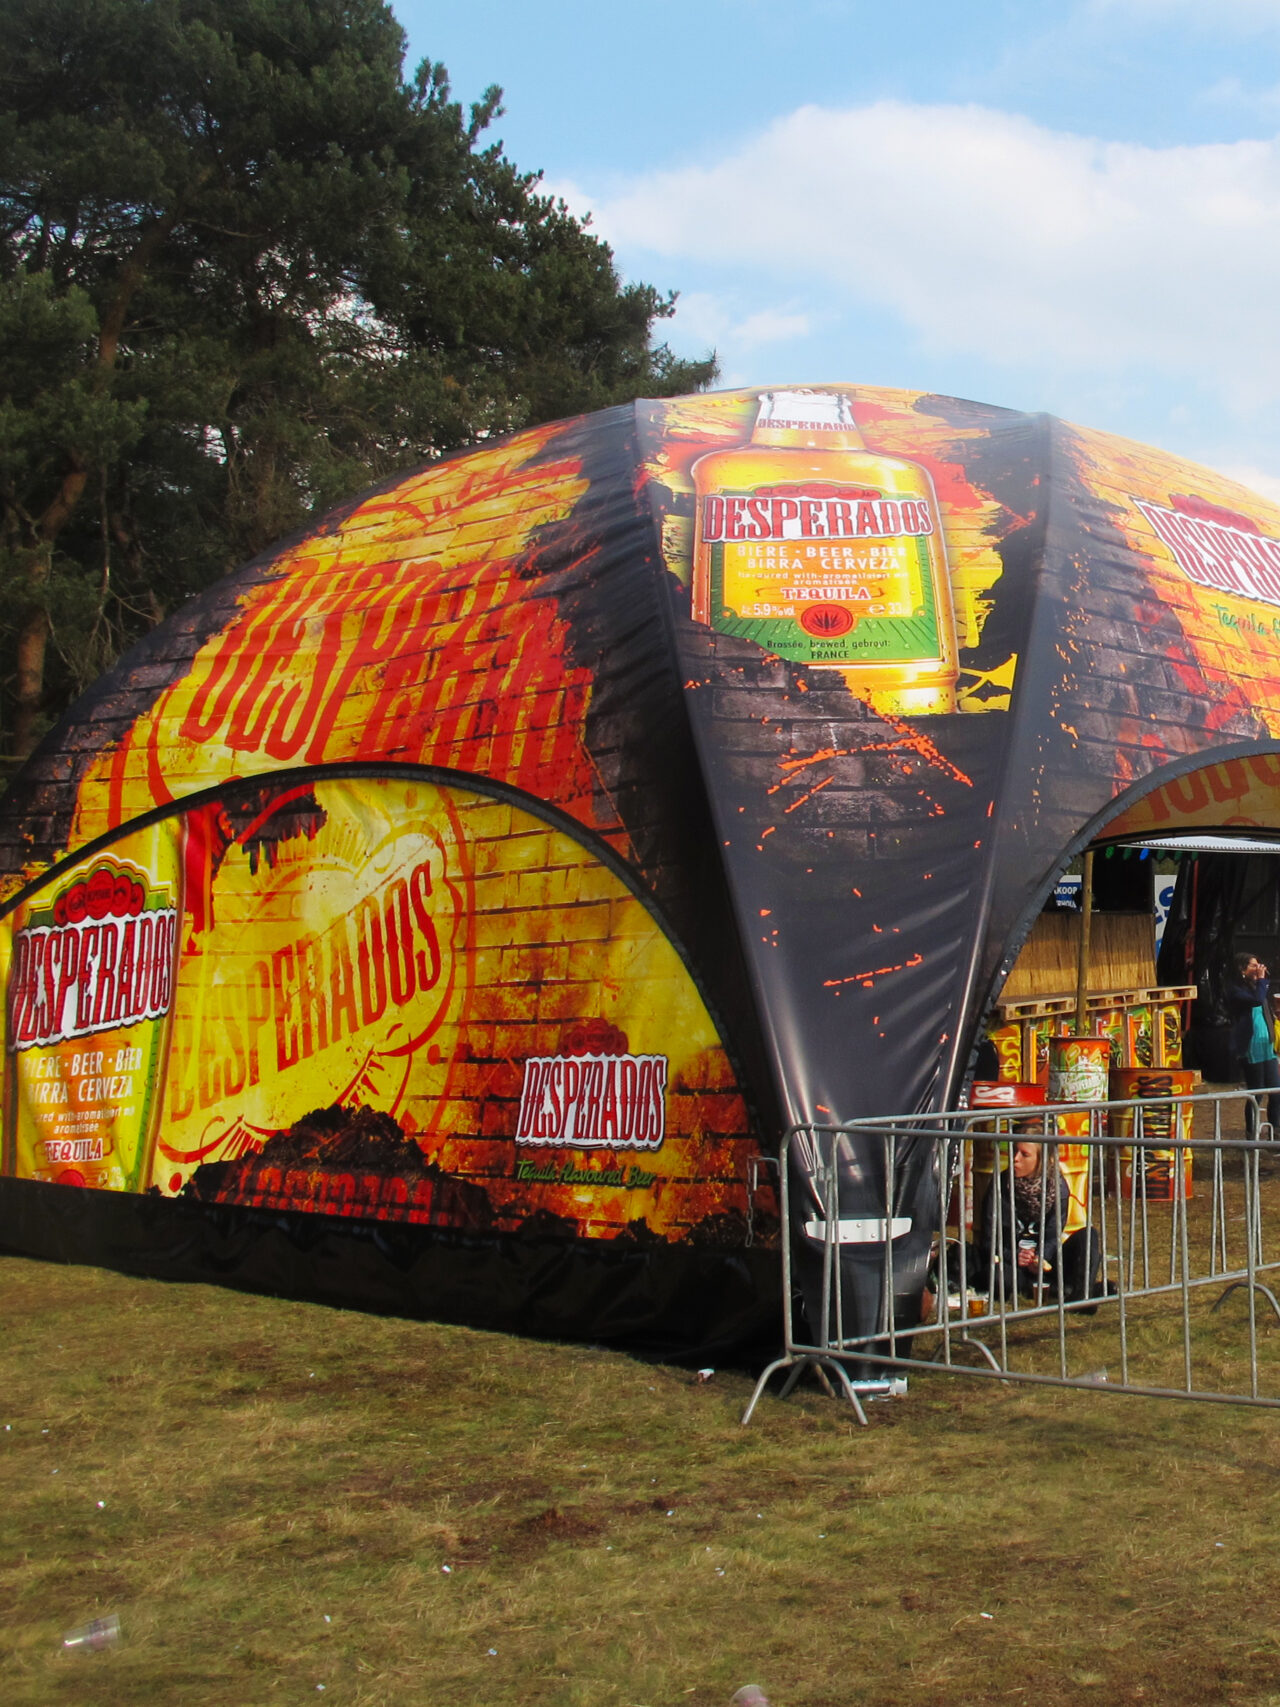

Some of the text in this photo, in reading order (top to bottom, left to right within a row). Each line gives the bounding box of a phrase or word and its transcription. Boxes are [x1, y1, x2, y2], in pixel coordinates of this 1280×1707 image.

[703, 495, 933, 541] DESPERADOS
[747, 558, 900, 570] BIRRA CERVEZA
[806, 546, 853, 558] BEER
[869, 547, 907, 557] BIER
[780, 587, 872, 601] TEQUILA
[810, 650, 850, 659] FRANCE
[11, 911, 176, 1043] DESPERADOS
[170, 859, 442, 1124] DESPERADOS
[71, 1051, 104, 1076] BEER
[115, 1047, 143, 1073] BIER
[78, 1076, 133, 1102] CERVEZA
[518, 1059, 665, 1142] DESPERADOS
[44, 1138, 104, 1164] TEQUILA
[625, 1165, 658, 1186] Beer
